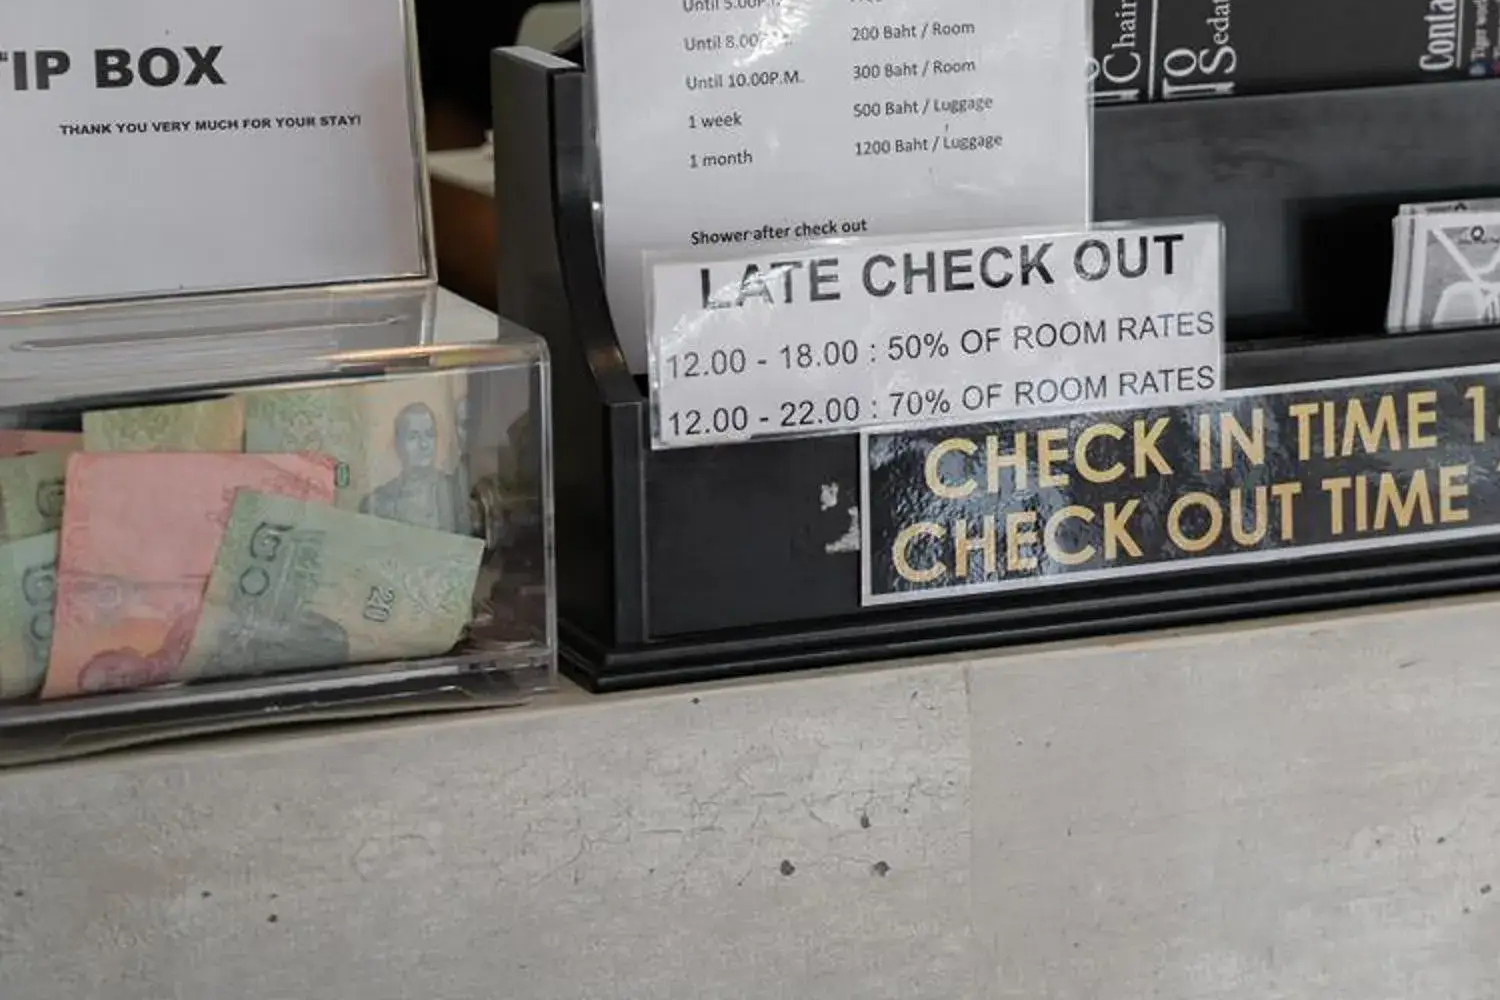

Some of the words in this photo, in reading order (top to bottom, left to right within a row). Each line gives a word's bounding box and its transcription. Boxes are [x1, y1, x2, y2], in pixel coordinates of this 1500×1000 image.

[852, 26, 879, 41] 200
[883, 24, 917, 39] Baht
[921, 23, 929, 39] /
[932, 21, 975, 36] Room
[684, 35, 721, 51] Until
[94, 46, 226, 88] BOX
[854, 64, 880, 79] 300
[885, 62, 918, 78] Baht
[922, 60, 930, 77] /
[933, 60, 976, 74] Room
[686, 74, 722, 91] Until
[728, 70, 804, 88] 10.00P.M.
[854, 103, 881, 118] 500
[885, 100, 918, 115] Baht
[922, 98, 930, 115] /
[934, 98, 993, 115] Luggage
[59, 124, 112, 136] THANK
[115, 122, 148, 134] YOU
[152, 121, 191, 133] VERY
[195, 120, 239, 131] MUCH
[243, 118, 272, 129] FOR
[276, 116, 316, 128] YOUR
[689, 115, 696, 128] 1
[701, 112, 742, 128] week
[855, 140, 891, 156] 1200
[895, 137, 928, 153] Baht
[932, 136, 940, 152] /
[943, 135, 1003, 150] Luggage
[689, 154, 698, 168] 1
[703, 149, 753, 166] month
[691, 230, 749, 246] Shower
[753, 224, 790, 241] after
[794, 219, 838, 237] check
[841, 218, 868, 234] out
[700, 258, 841, 309] LATE
[862, 242, 1054, 297] CHECK
[1073, 234, 1184, 282] OUT
[666, 350, 746, 379] 12.00
[780, 339, 858, 370] 18.00
[887, 331, 949, 362] 50%
[961, 327, 1001, 355] OF
[1013, 319, 1107, 350] ROOM
[1118, 310, 1215, 341] RATES
[669, 406, 749, 437] 12.00
[780, 396, 859, 428] 22.00
[889, 385, 950, 418] 70%
[962, 383, 1003, 410] OF
[1014, 374, 1107, 405] ROOM
[1119, 365, 1216, 397] RATES
[924, 417, 1173, 500] CHECK
[1198, 408, 1264, 470] IN
[1289, 390, 1438, 461] TIME
[892, 499, 1143, 583] CHECK
[1167, 481, 1301, 552] OUT
[1322, 465, 1469, 536] TIME
[363, 584, 395, 622] 20
